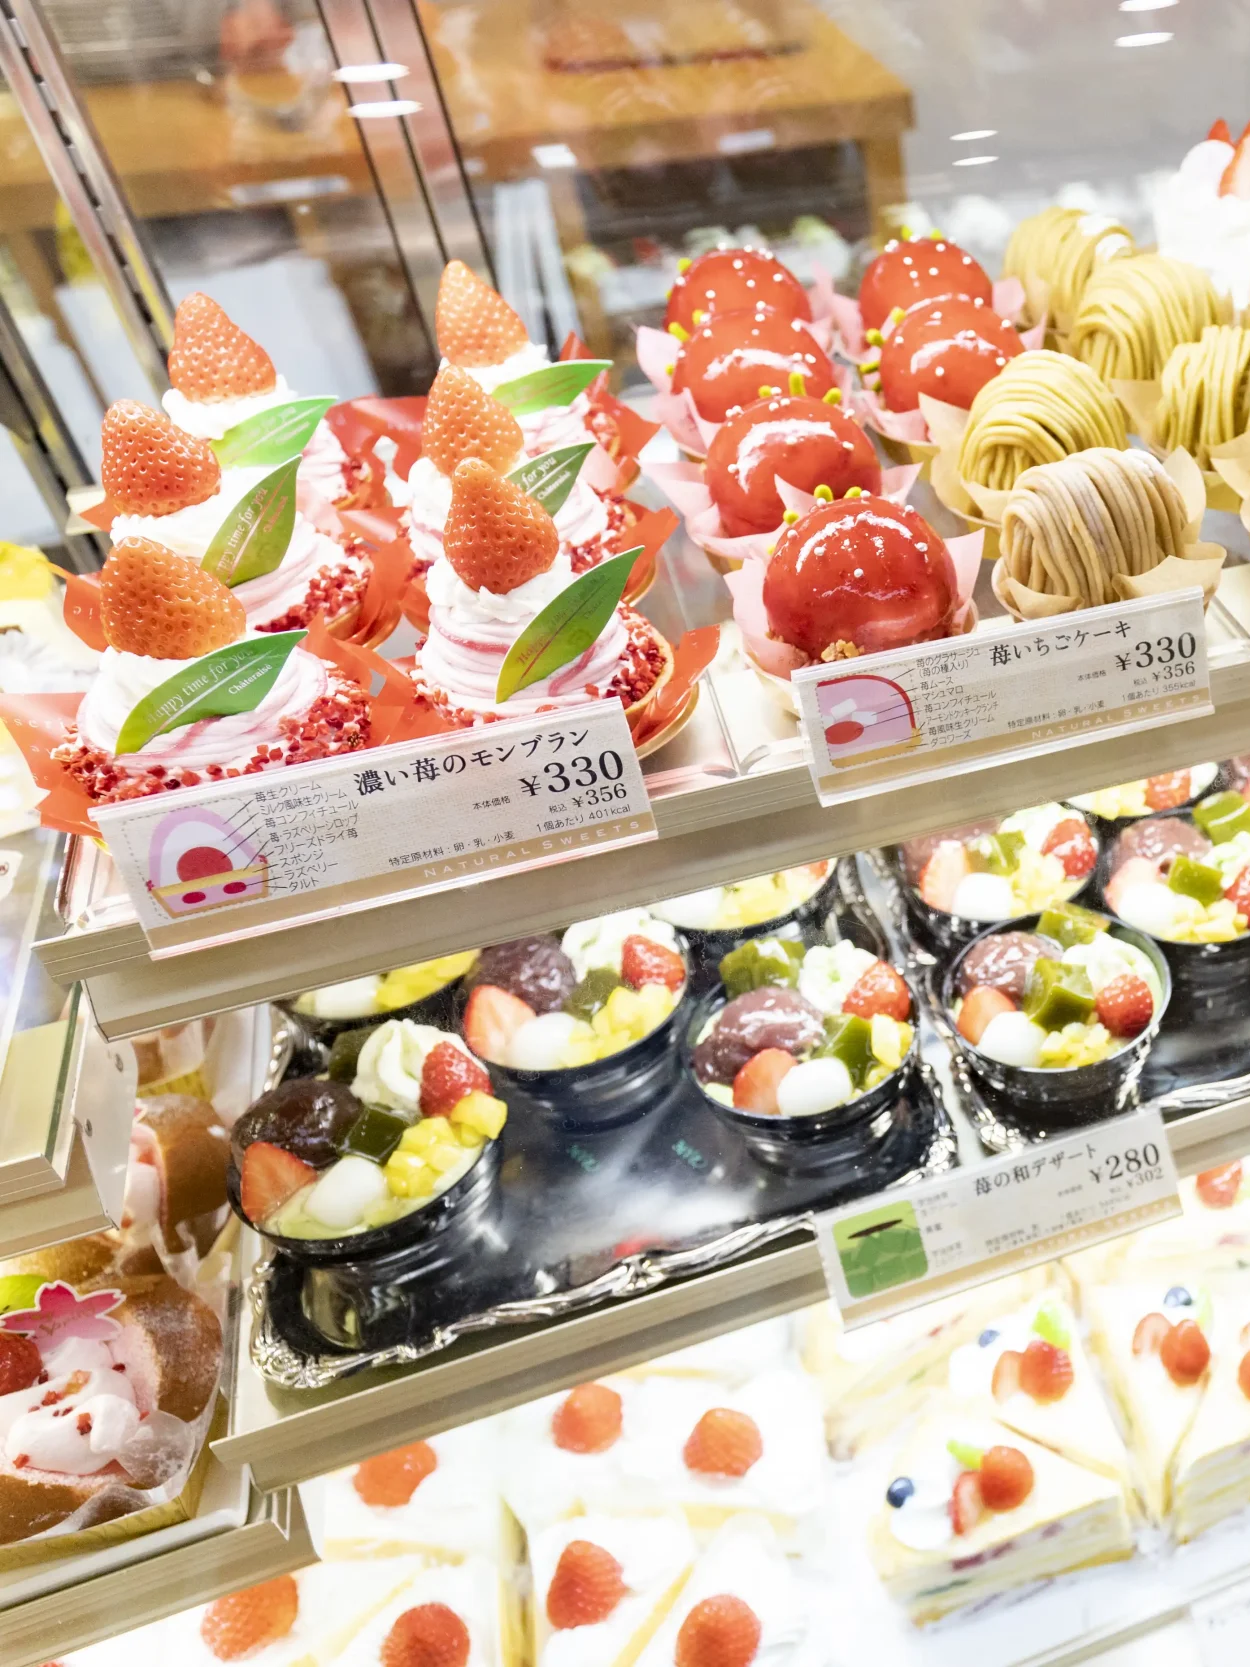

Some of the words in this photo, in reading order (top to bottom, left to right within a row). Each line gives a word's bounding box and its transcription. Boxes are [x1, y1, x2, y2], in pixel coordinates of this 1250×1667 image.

[521, 470, 537, 490] for
[537, 456, 557, 477] you
[238, 506, 255, 529] for
[989, 620, 1132, 667] 苺いちごケーキ
[1077, 669, 1107, 682] 本体価格
[1115, 631, 1197, 672] ¥330
[916, 648, 980, 668] 苺のグラサージュ
[182, 675, 209, 696] time
[208, 661, 228, 682] for
[920, 676, 954, 691] 苺ムース
[1152, 661, 1196, 682] ¥356
[922, 685, 964, 700] マシュマロ
[924, 690, 997, 713] 苺コンフィチュール
[1122, 687, 1159, 702] 1個あたり
[1162, 679, 1196, 693] 355kcal
[928, 714, 995, 736] 苺風味生クリーム
[1032, 715, 1114, 740] NATURAL
[1123, 694, 1200, 718] SWEETS
[930, 729, 972, 748] ダコワーズ
[353, 729, 589, 796] 濃い苺のモンブラン
[254, 780, 322, 801] 苺生クリーム
[472, 795, 511, 811] 本体価格
[518, 750, 624, 797] ¥330
[259, 789, 347, 815] ミルク風味生クリーム
[548, 803, 568, 814] 税込
[572, 783, 628, 809] ¥356
[265, 800, 358, 828] 苺コンフィチュール
[536, 815, 585, 833] 1個あたり
[588, 803, 631, 821] 401kcal
[273, 828, 358, 855] フリーズドライ苺
[424, 847, 531, 879] NATURAL
[542, 820, 641, 850] SWEETS
[279, 849, 323, 868] スポンジ
[284, 862, 338, 880] ラズベリー
[288, 876, 319, 892] タルト
[973, 1143, 1097, 1197] 苺の和デザート
[1089, 1142, 1160, 1184] ¥280
[1126, 1167, 1165, 1189] ¥302
